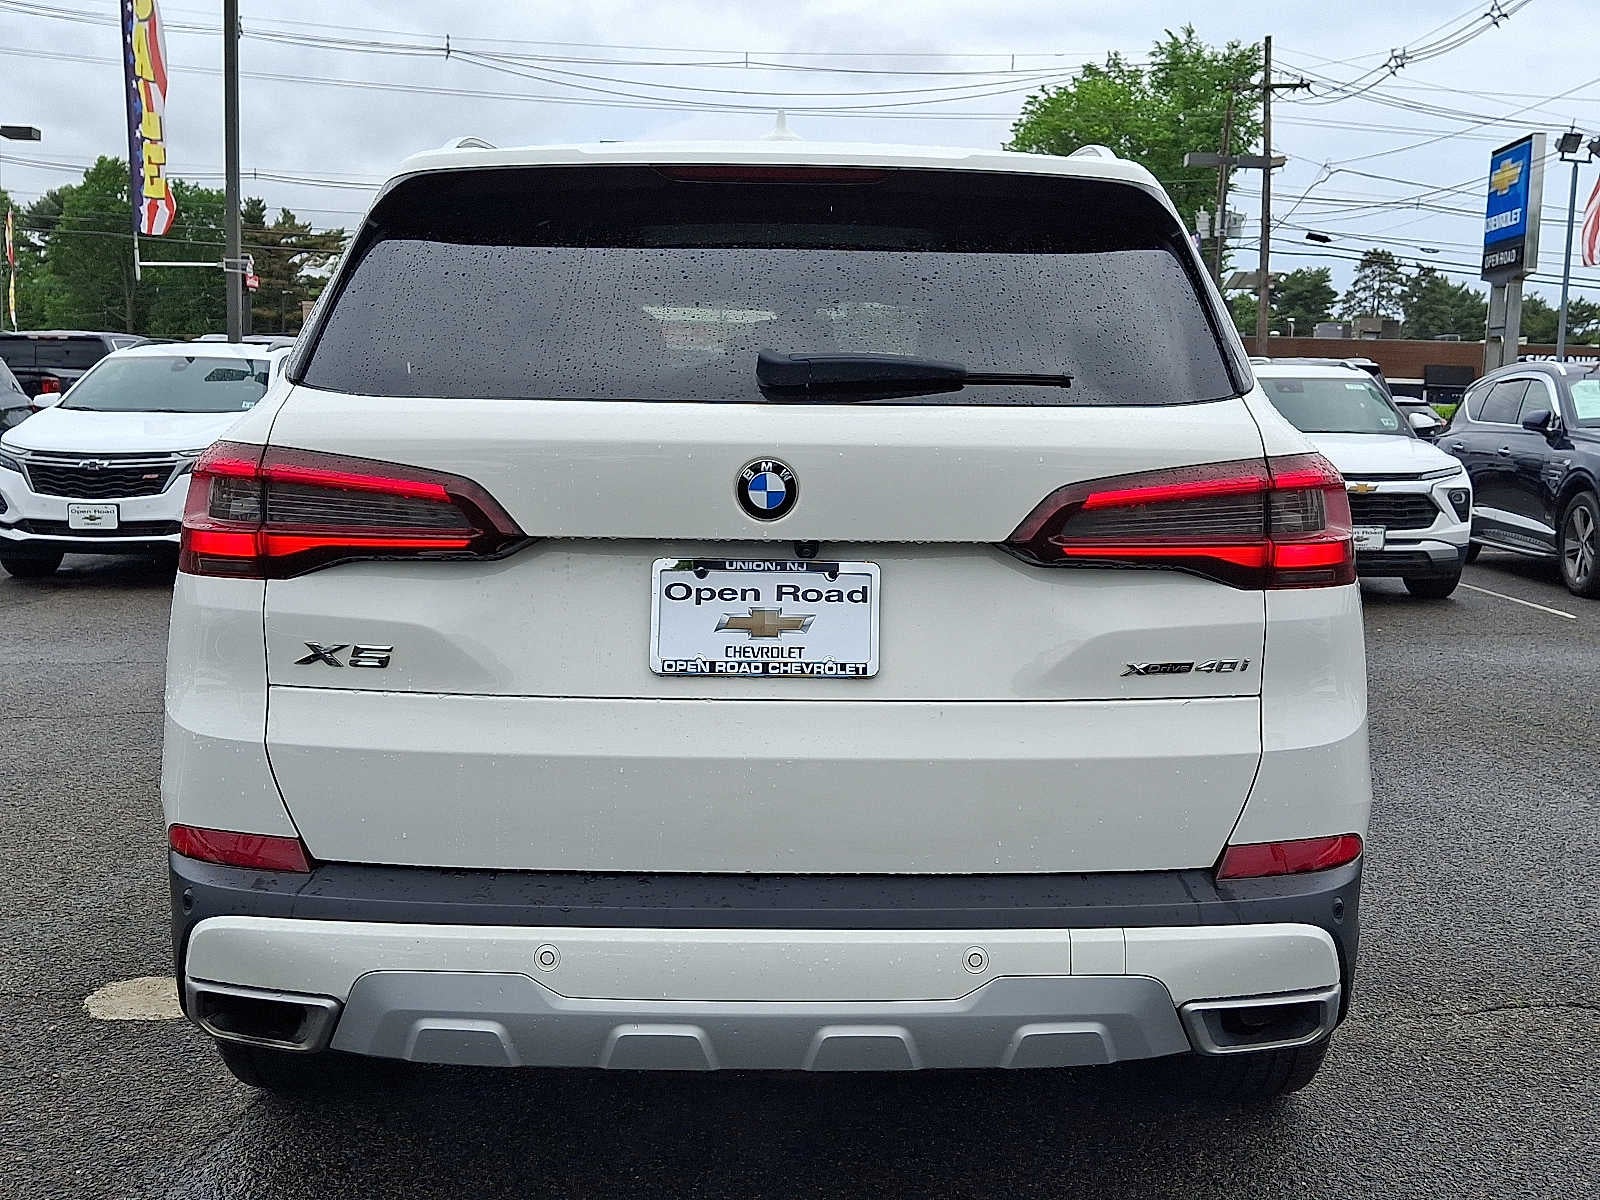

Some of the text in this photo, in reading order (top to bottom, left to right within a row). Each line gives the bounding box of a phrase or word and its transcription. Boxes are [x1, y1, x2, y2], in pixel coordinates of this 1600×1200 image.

[1484, 249, 1517, 269] OPEN ROAD
[743, 461, 792, 481] BMW
[725, 560, 807, 572] UNION, NJ
[664, 582, 868, 605] Open Road
[294, 641, 394, 669] X5
[725, 645, 805, 659] CHEVROLET
[663, 661, 866, 675] OPEN ROAD CHEVROLET
